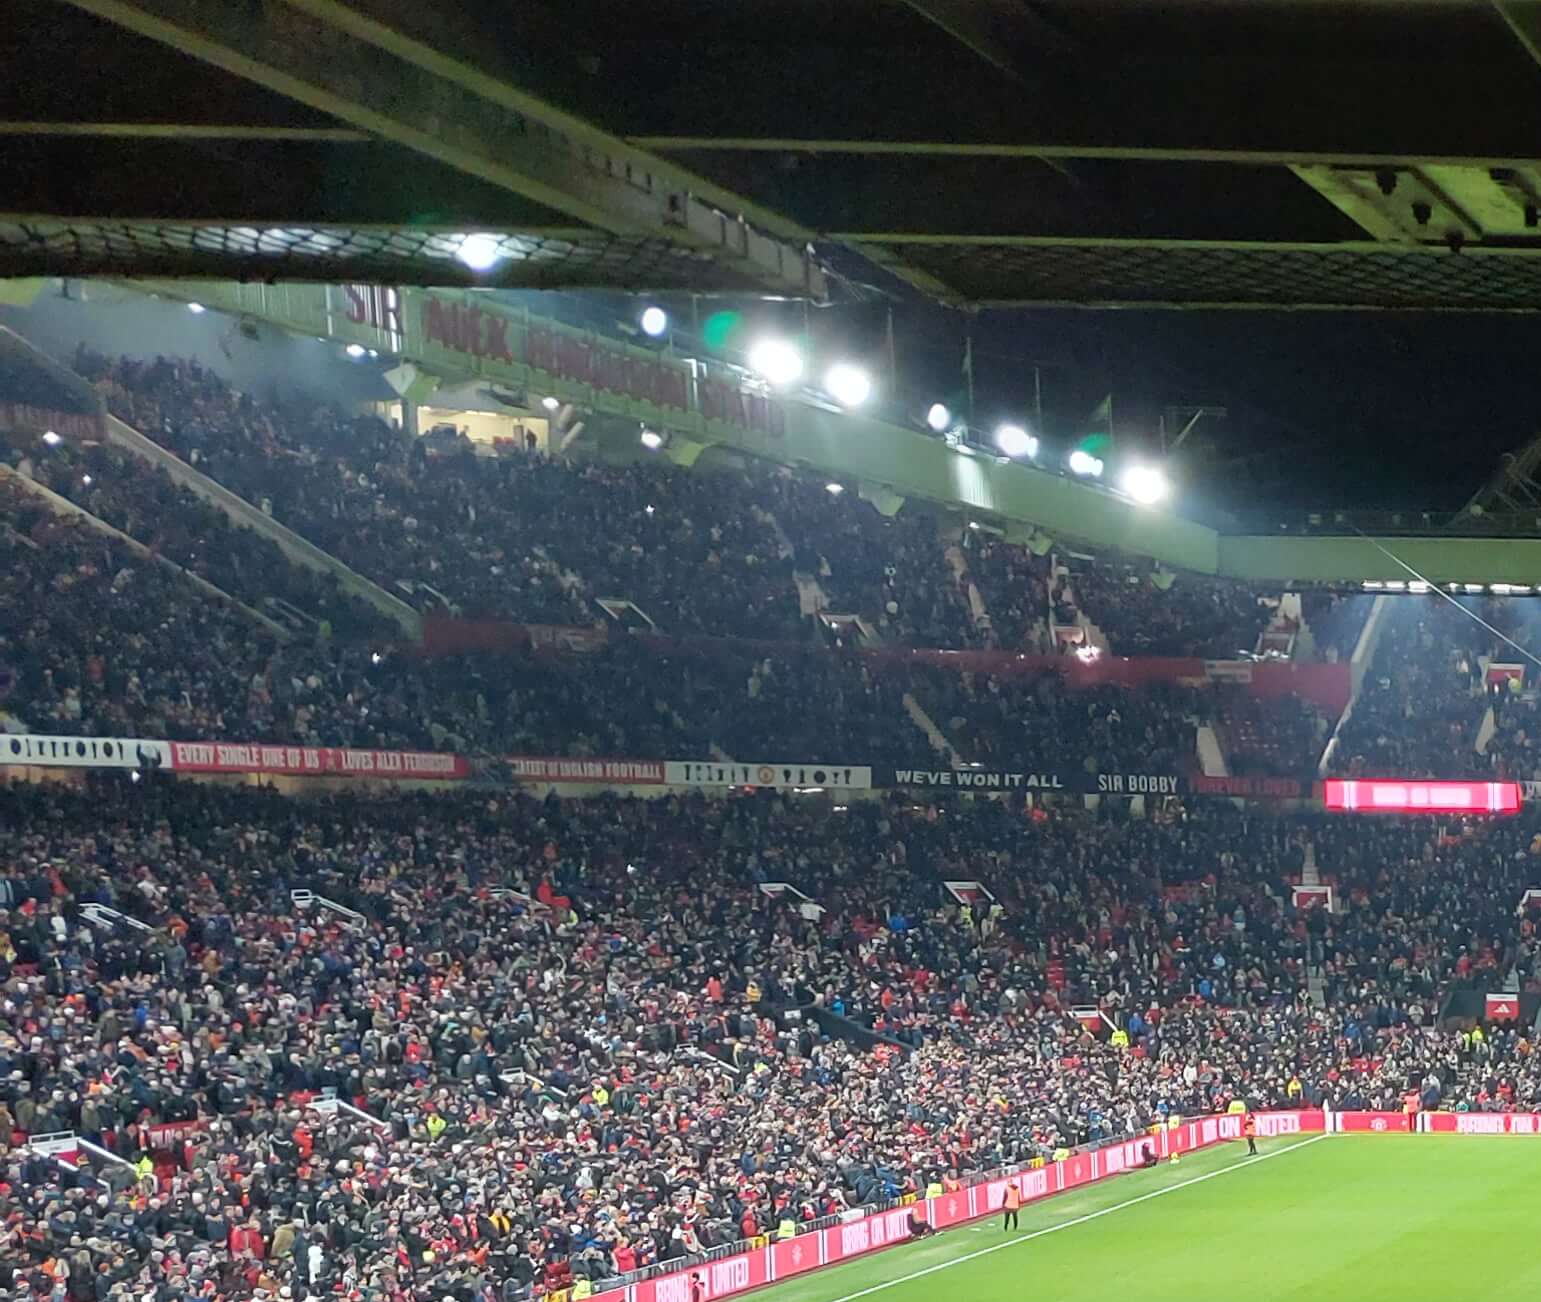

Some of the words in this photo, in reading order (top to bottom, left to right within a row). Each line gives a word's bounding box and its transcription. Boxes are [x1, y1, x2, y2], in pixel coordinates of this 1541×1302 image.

[177, 743, 215, 764] EVERY
[217, 745, 258, 766] SINGLE
[261, 747, 285, 767] ONE
[287, 748, 301, 768] OF
[304, 749, 320, 768] US
[341, 751, 373, 769] LOVES
[376, 751, 400, 770] ALEX
[606, 762, 662, 778] FOOTBALL
[896, 770, 950, 785] WE'VE
[956, 772, 999, 786] WON
[1004, 774, 1023, 787] IT
[1026, 774, 1064, 788] ALL
[1098, 774, 1123, 792] SIR
[1129, 775, 1178, 793] BOBBY
[1219, 1116, 1241, 1137] ON
[712, 1256, 749, 1296] UNITED
